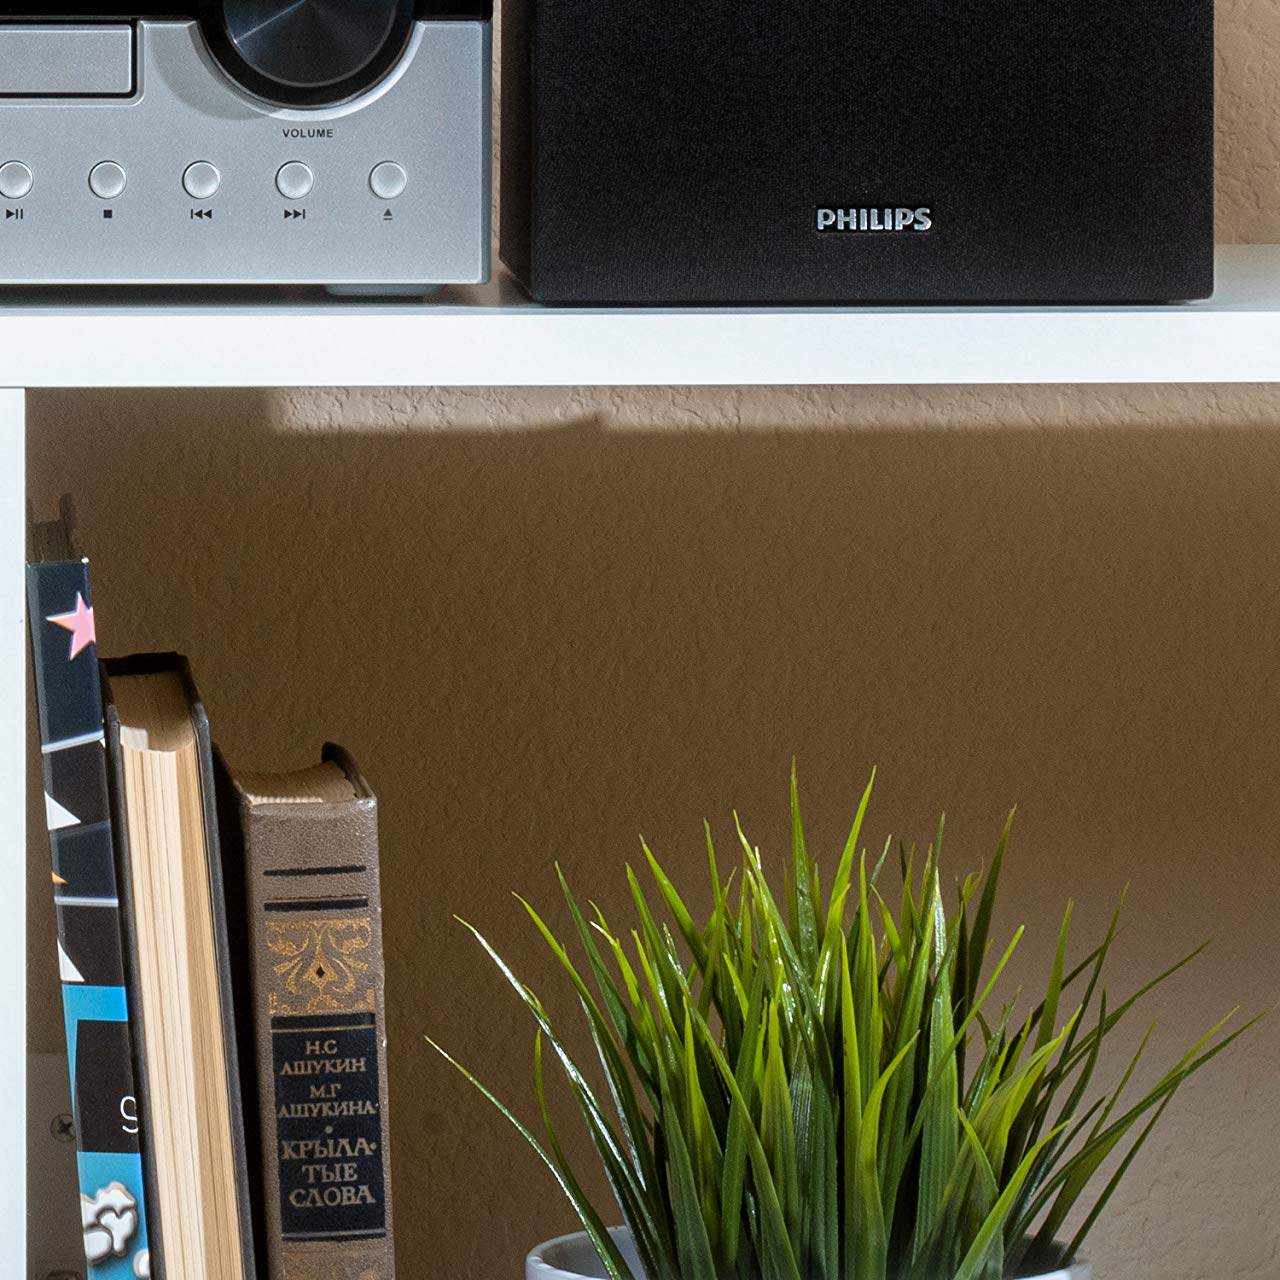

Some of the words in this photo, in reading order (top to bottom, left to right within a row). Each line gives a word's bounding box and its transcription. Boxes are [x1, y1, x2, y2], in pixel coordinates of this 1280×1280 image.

[282, 128, 334, 139] VOLUME
[817, 207, 932, 231] PHILIPS
[279, 1056, 367, 1076] АШУКИН
[277, 1099, 378, 1119] АШУКИНА
[301, 1162, 359, 1183] ТЫЕ
[289, 1184, 377, 1208] СЛОВА
